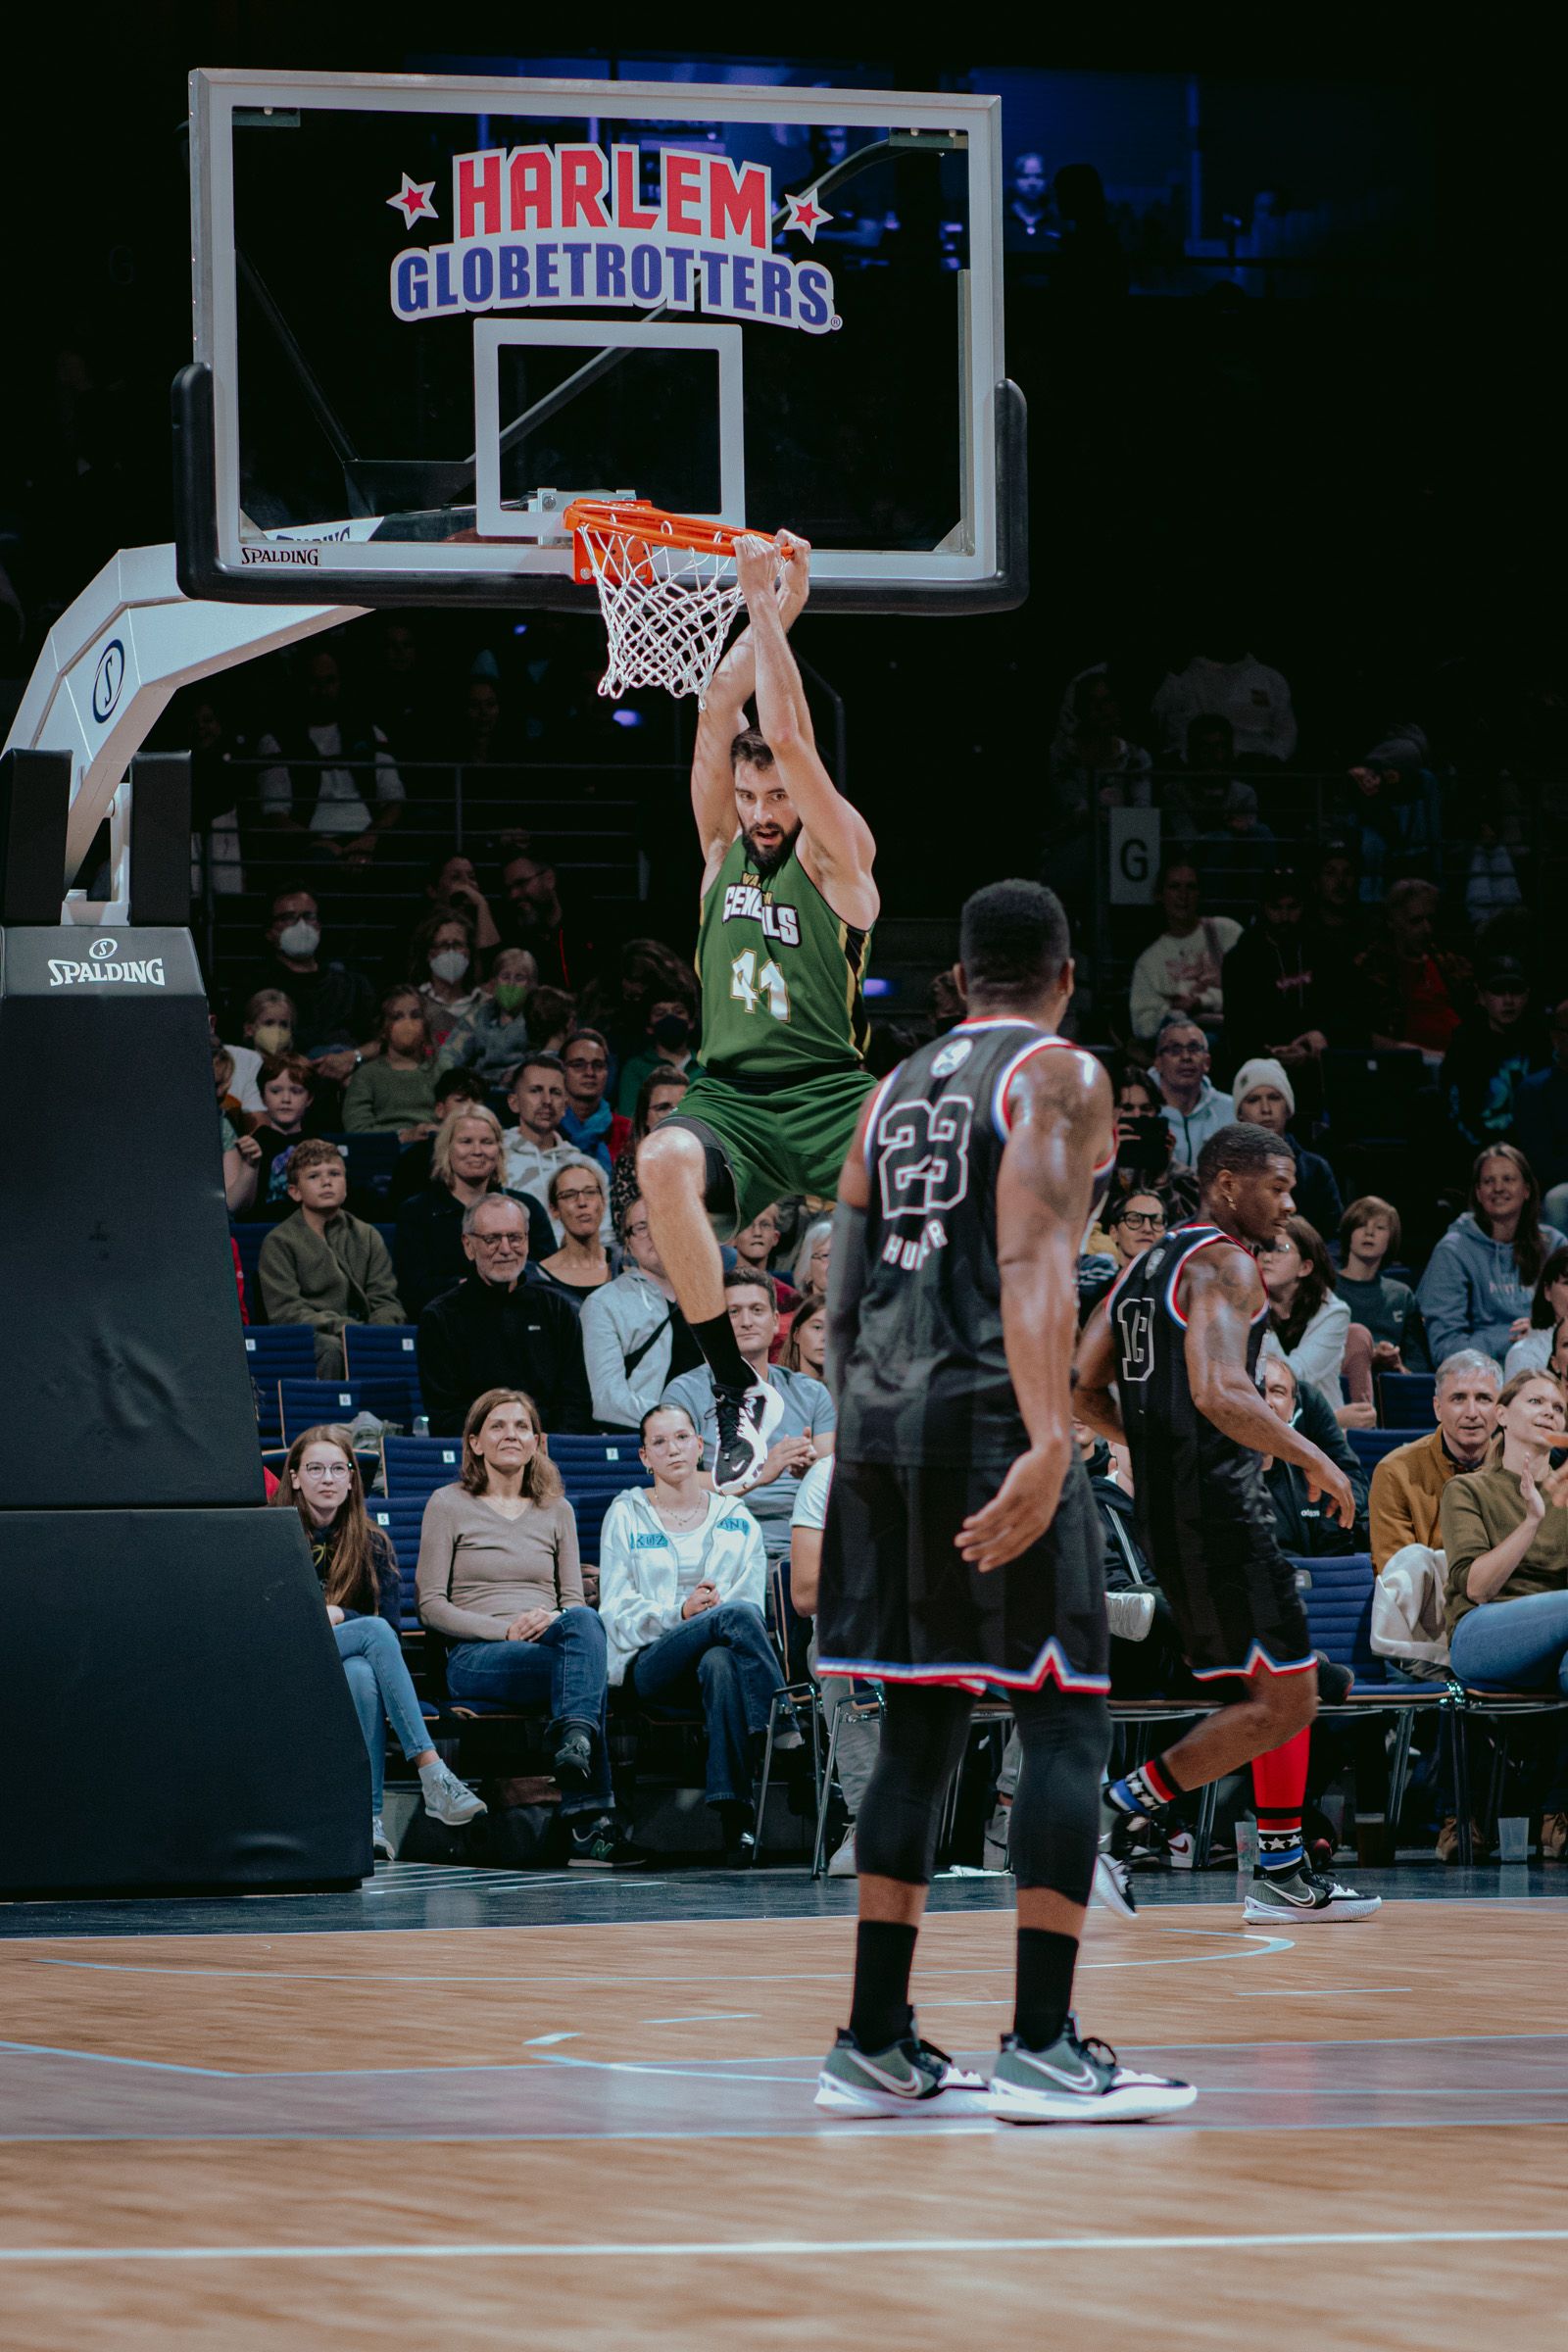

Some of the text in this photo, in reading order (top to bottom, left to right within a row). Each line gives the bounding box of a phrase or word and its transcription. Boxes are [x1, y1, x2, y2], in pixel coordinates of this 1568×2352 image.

[459, 148, 766, 251] HARLEM
[396, 242, 830, 327] GLOBETROTTERS
[241, 547, 318, 566] SPALDING
[1120, 839, 1149, 882] G
[47, 957, 166, 987] SPALDING
[878, 1093, 974, 1220] 23
